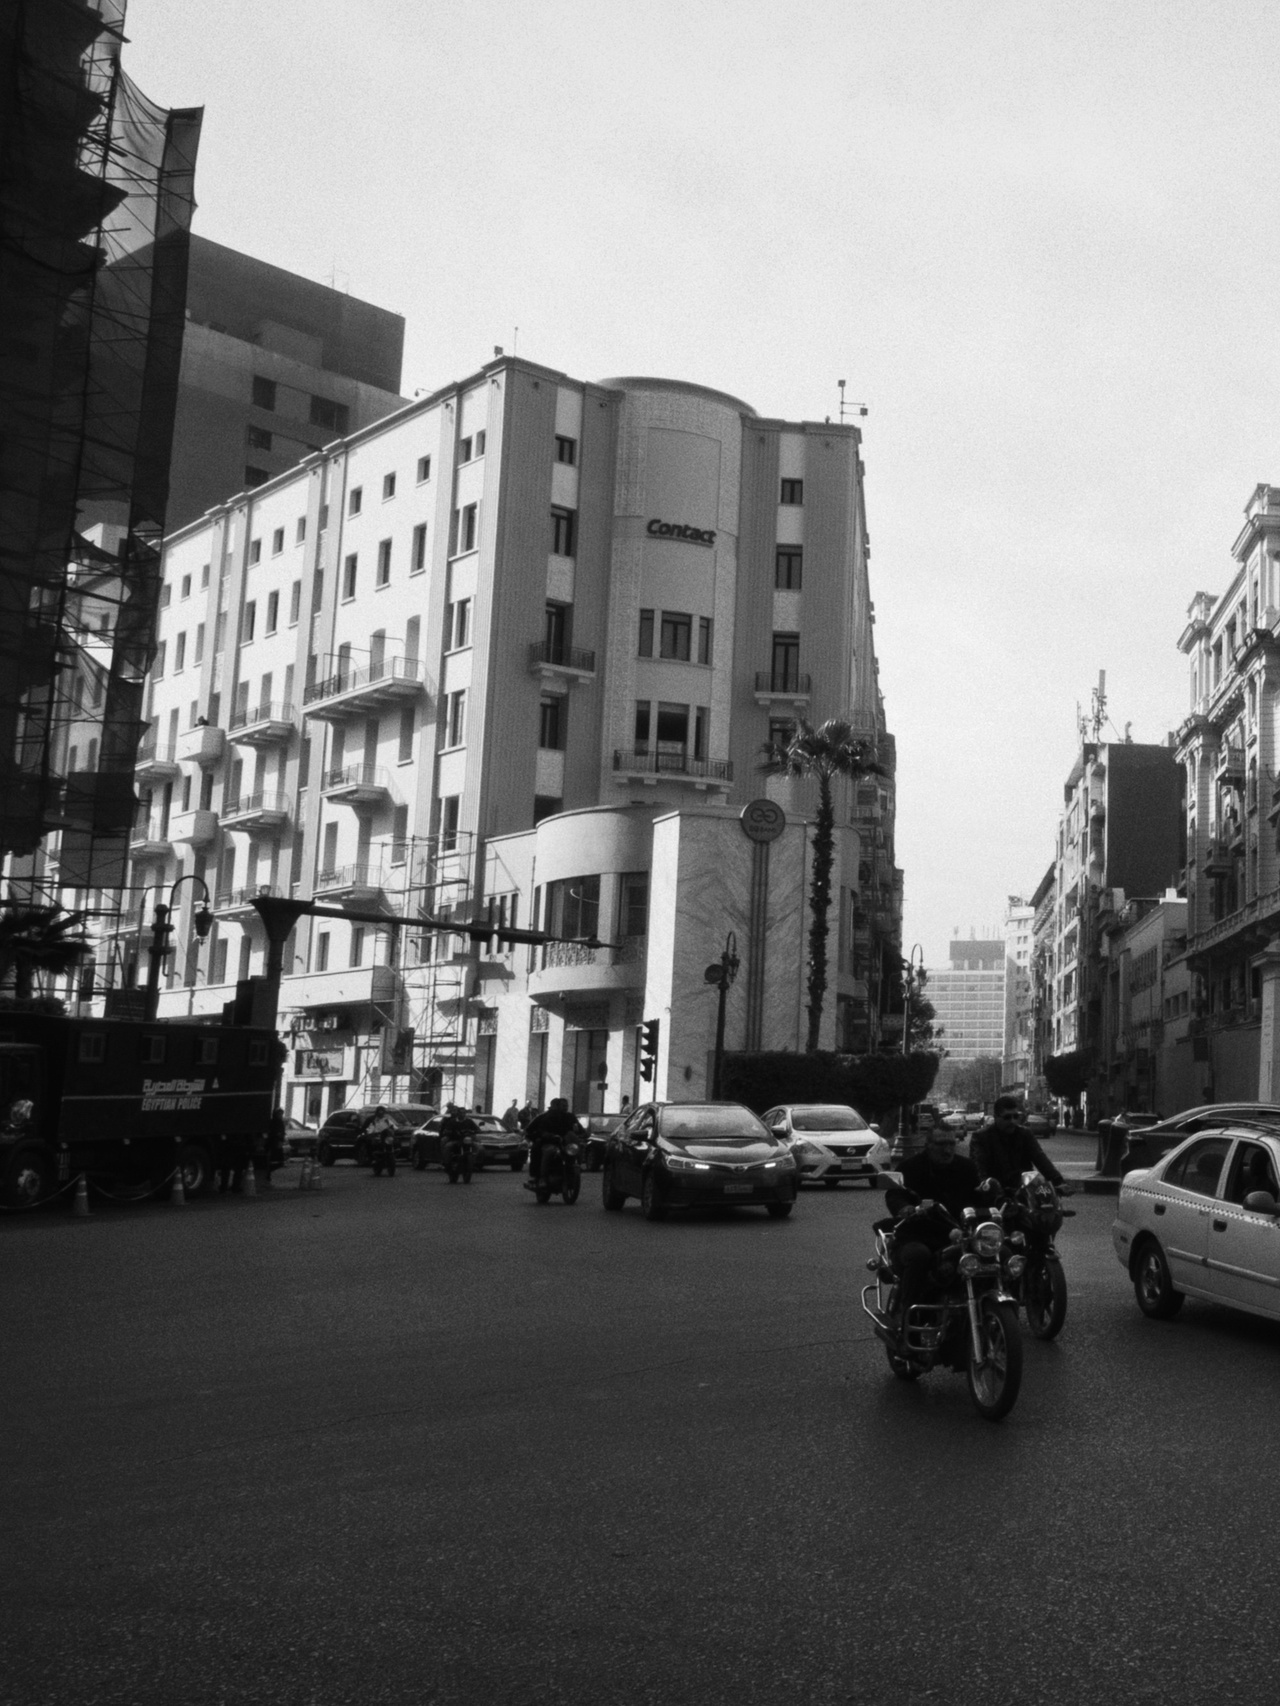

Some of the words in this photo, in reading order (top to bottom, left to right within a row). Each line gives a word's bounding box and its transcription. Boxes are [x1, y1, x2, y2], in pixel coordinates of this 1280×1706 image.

[647, 519, 717, 545] Contact
[141, 1098, 176, 1111] EGYPTIAN
[177, 1097, 202, 1110] POLICE
